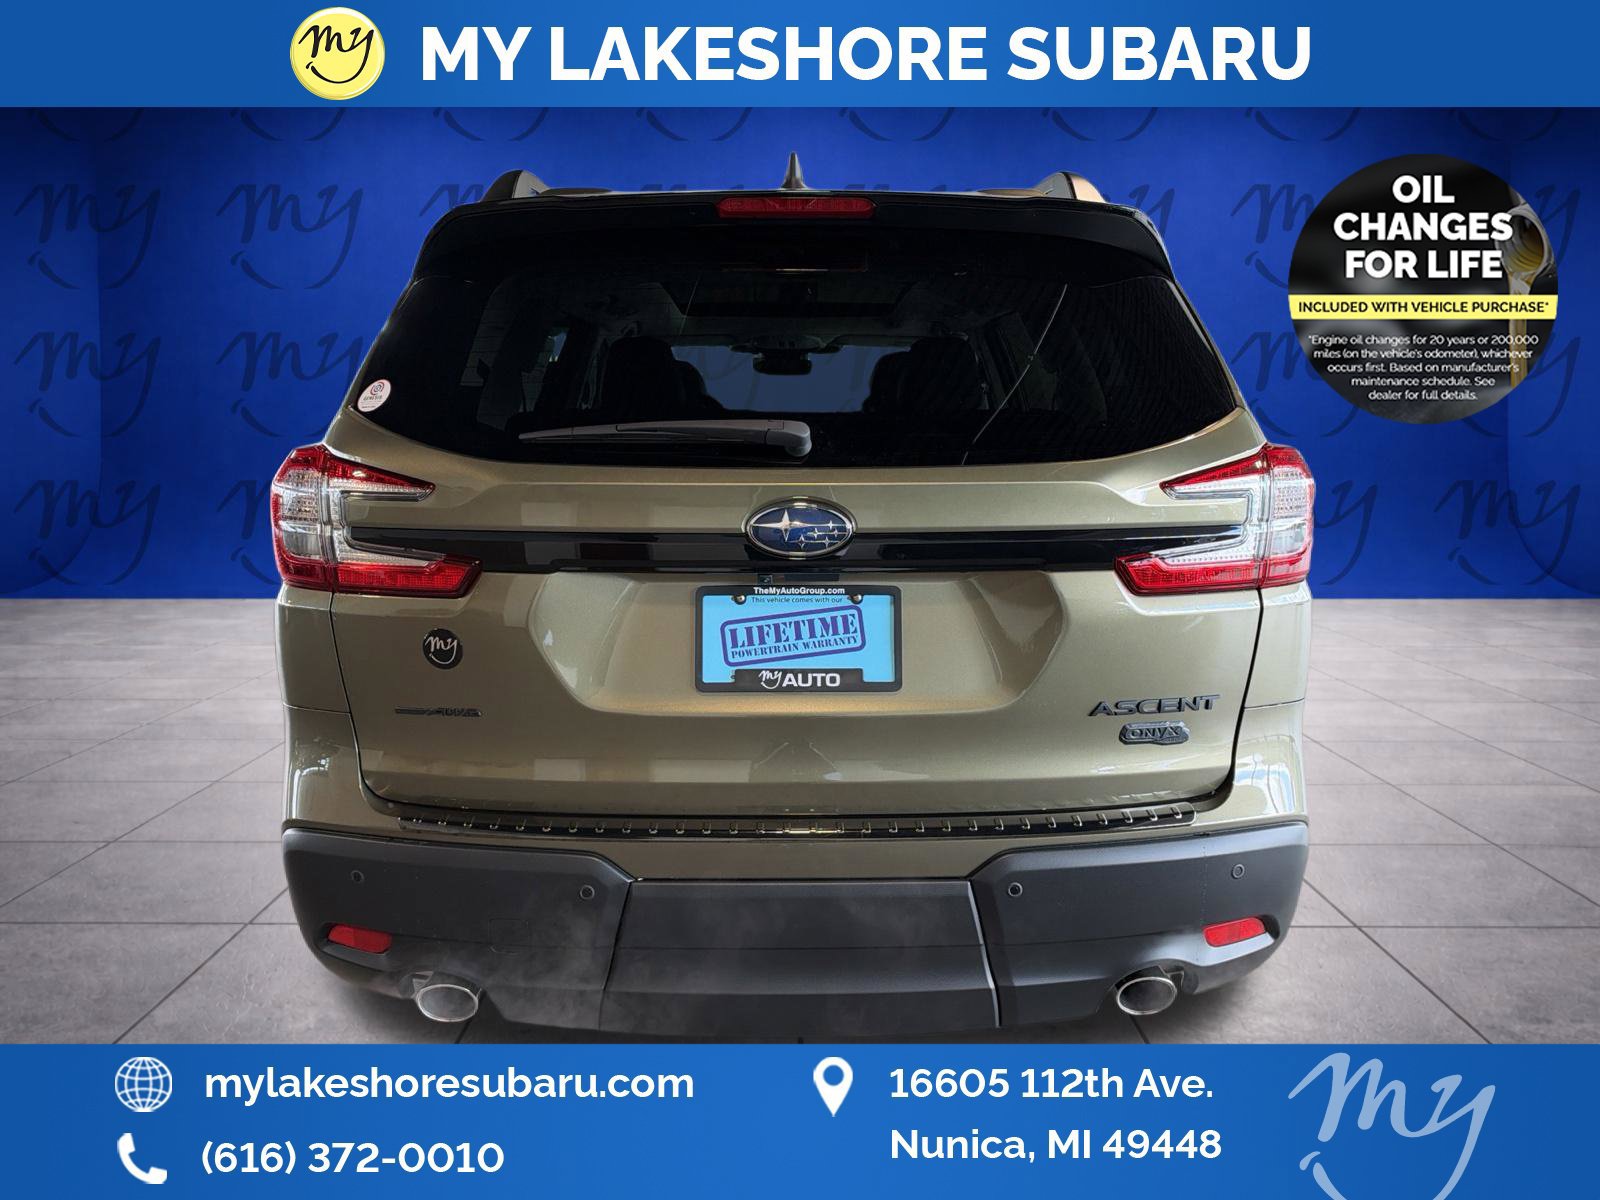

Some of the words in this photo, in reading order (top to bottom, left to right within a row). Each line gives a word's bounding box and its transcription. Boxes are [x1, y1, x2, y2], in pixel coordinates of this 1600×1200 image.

[753, 586, 846, 596] TheMyAutoGroup.com
[729, 613, 859, 650] LIFETIME
[731, 642, 800, 659] POWERTRAIN
[802, 635, 859, 650] WARRANTY
[782, 673, 841, 687] AUTO
[1088, 694, 1220, 716] ASCENT
[1128, 726, 1181, 740] ONYX
